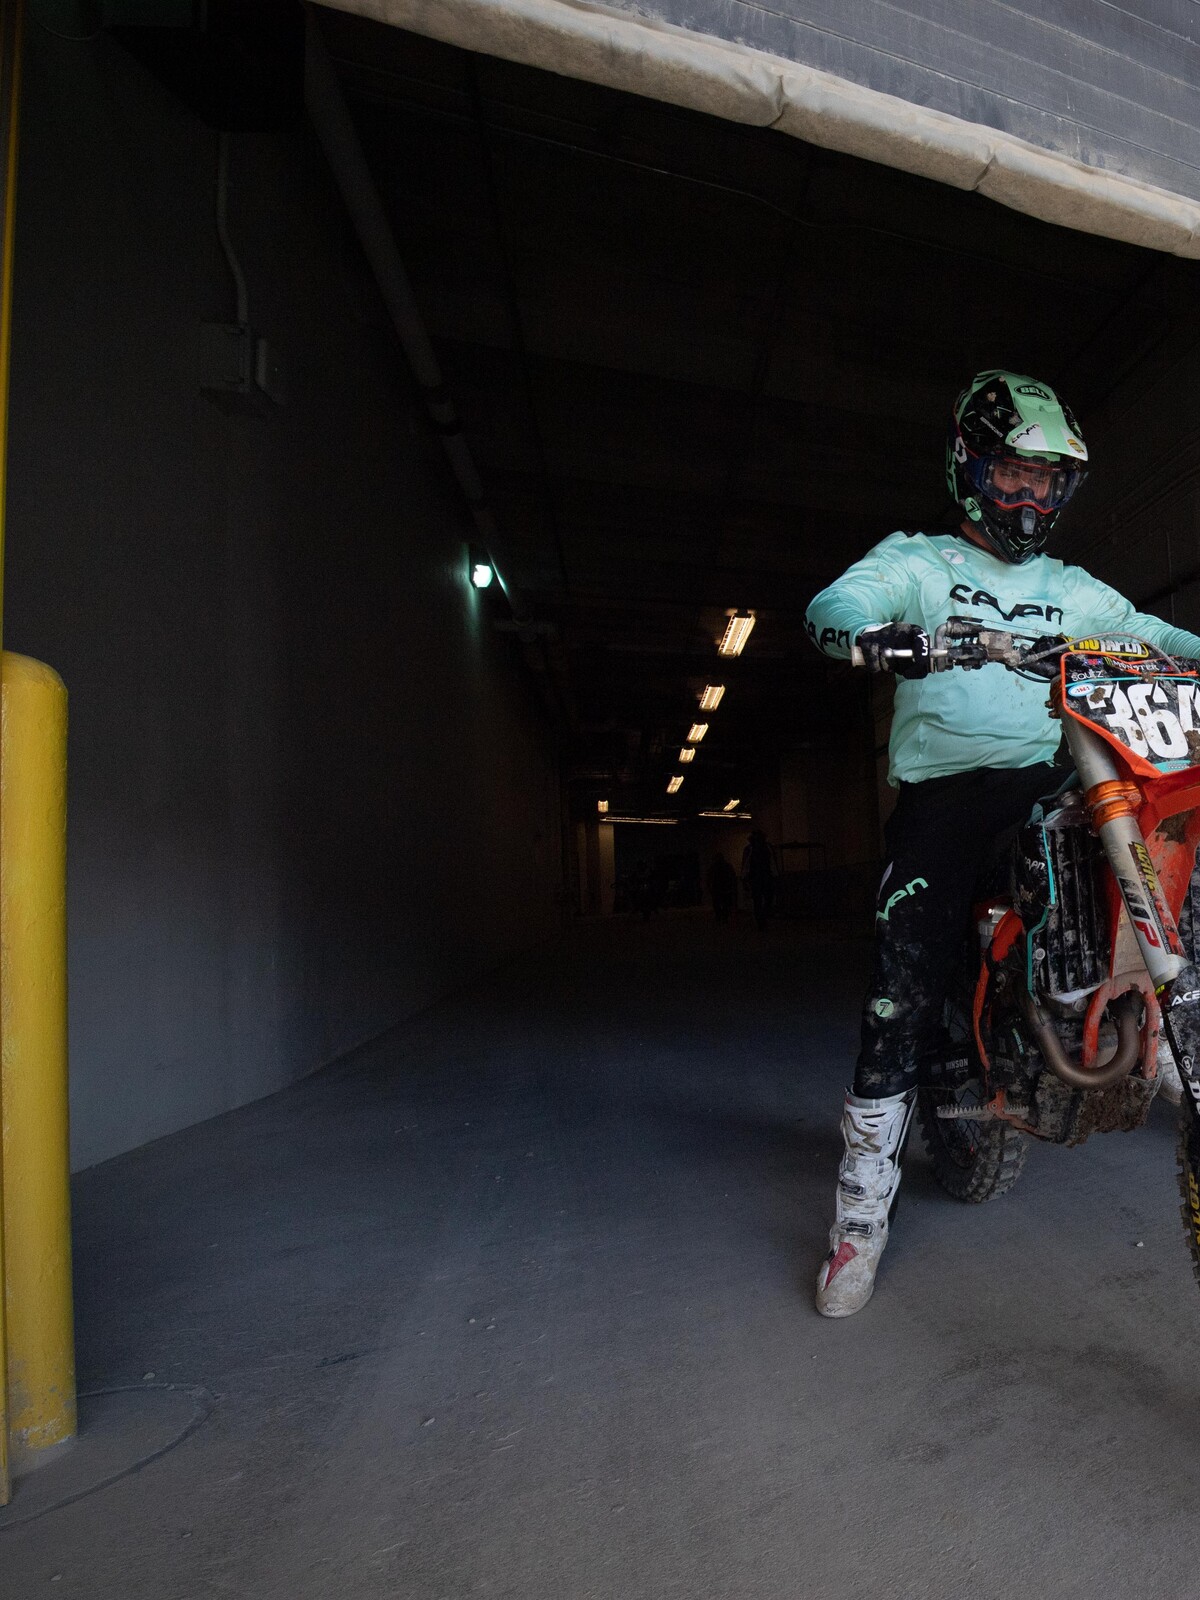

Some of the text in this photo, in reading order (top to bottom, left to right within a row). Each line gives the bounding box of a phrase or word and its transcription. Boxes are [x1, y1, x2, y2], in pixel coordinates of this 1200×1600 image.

[1020, 386, 1047, 399] BELL
[1112, 659, 1159, 672] MONSTER
[876, 877, 929, 921] ven
